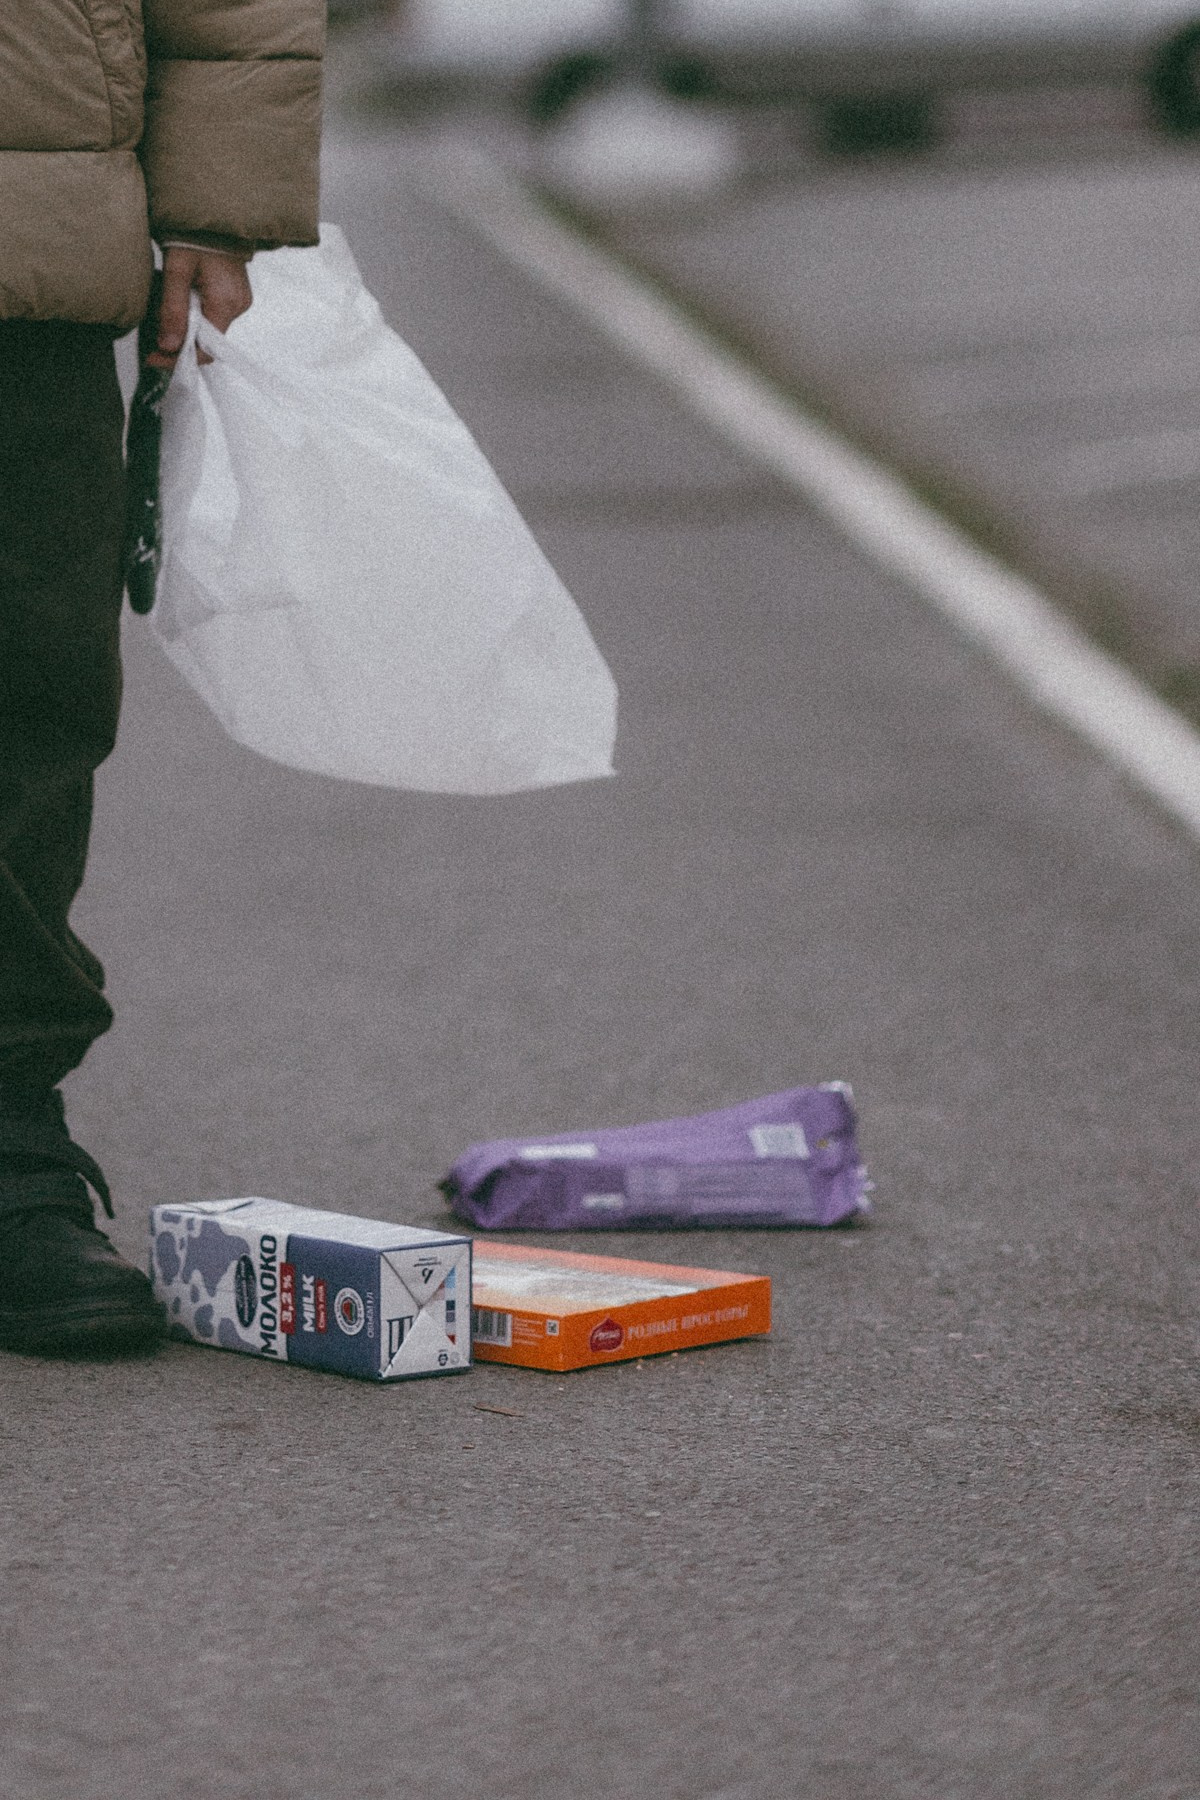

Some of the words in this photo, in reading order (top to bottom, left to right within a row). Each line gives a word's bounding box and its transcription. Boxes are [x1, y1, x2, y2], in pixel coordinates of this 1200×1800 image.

[260, 1234, 278, 1356] МОЛОКО
[281, 1292, 294, 1323] 3,2
[302, 1274, 315, 1332] MILK
